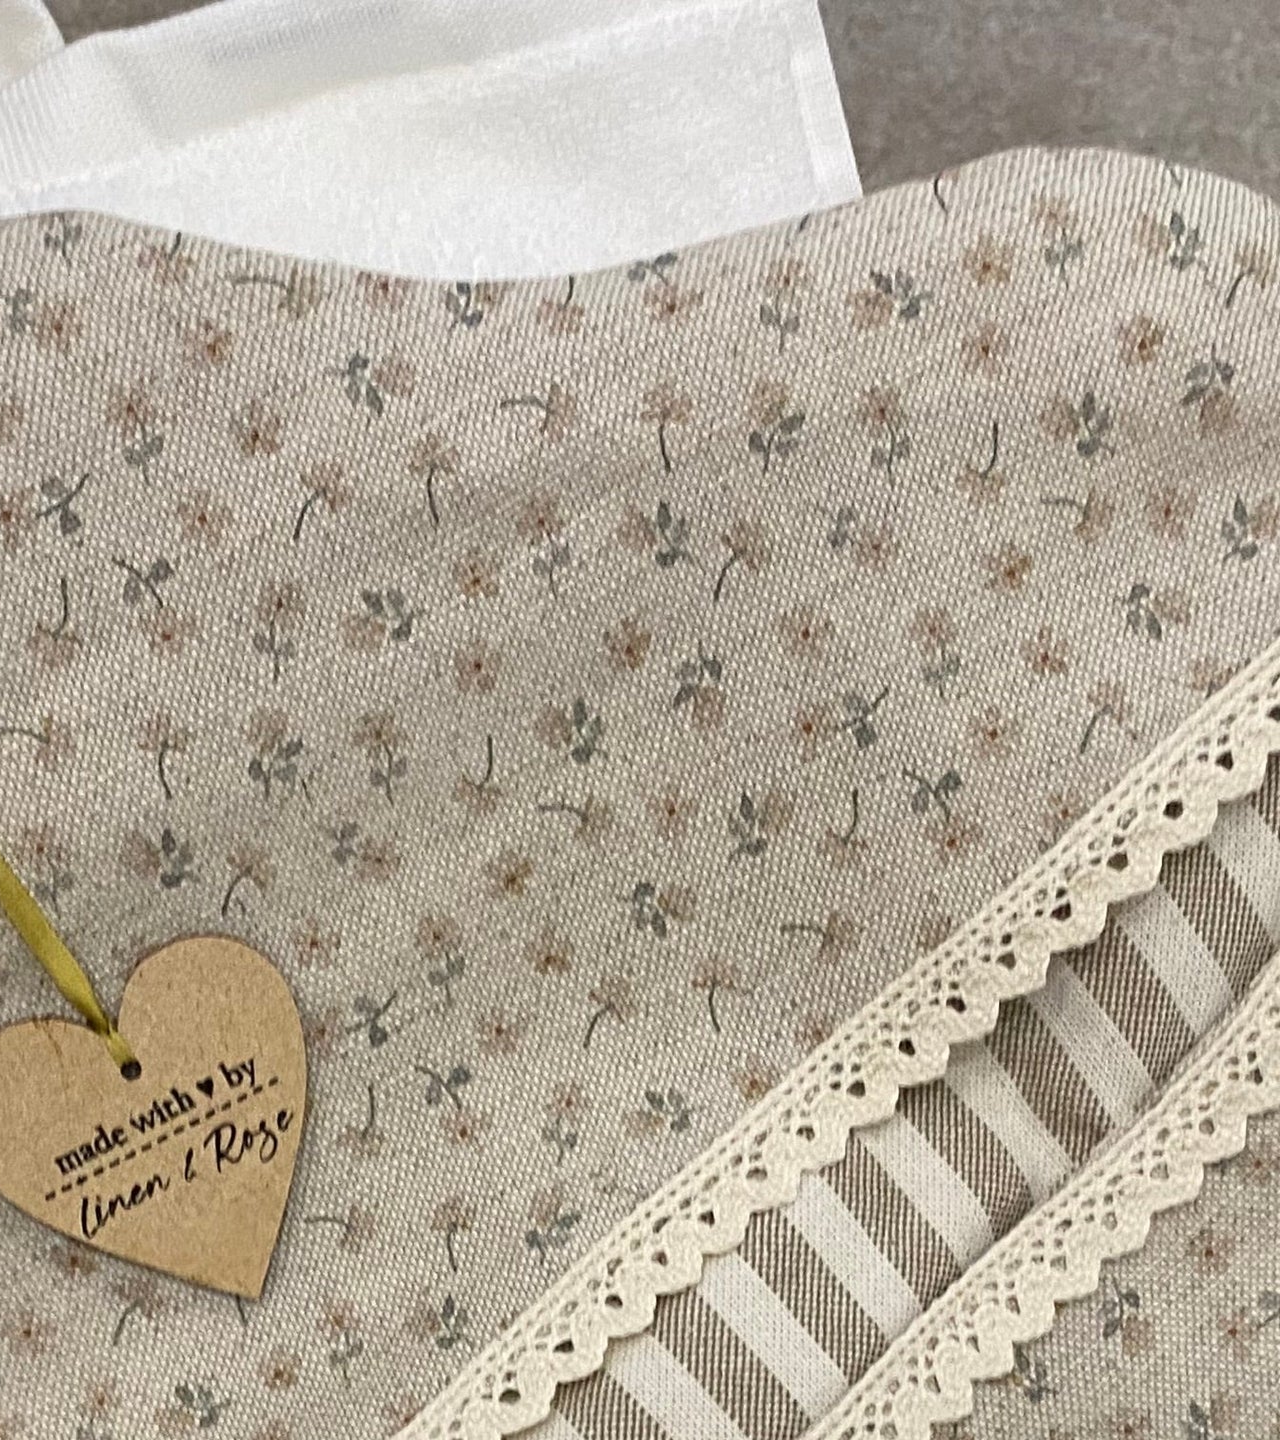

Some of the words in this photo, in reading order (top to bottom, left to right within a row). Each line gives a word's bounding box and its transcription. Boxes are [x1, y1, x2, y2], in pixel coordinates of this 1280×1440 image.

[55, 1124, 128, 1175] made
[130, 1088, 197, 1134] with
[219, 1058, 255, 1088] by
